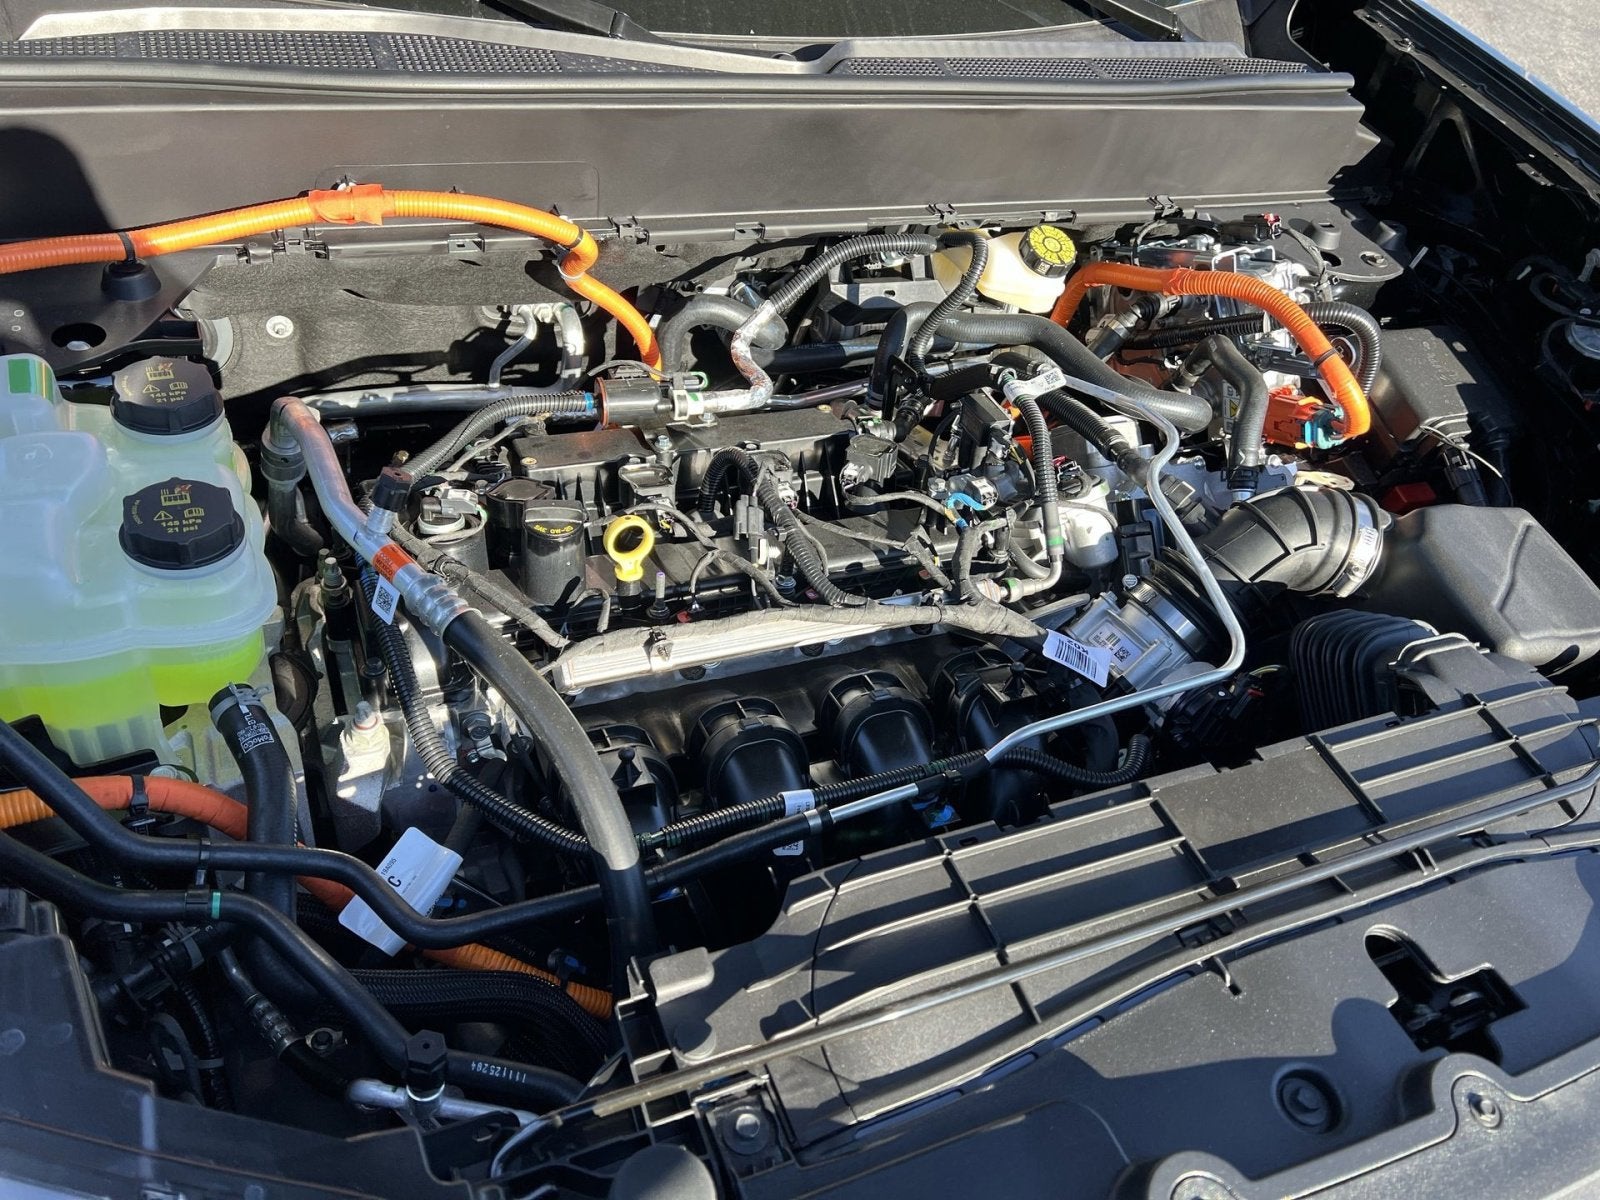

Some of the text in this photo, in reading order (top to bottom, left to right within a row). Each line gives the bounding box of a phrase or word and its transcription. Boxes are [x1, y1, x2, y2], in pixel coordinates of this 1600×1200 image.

[533, 524, 548, 533] SAE
[242, 733, 273, 750] FoMoCo
[387, 875, 401, 887] C
